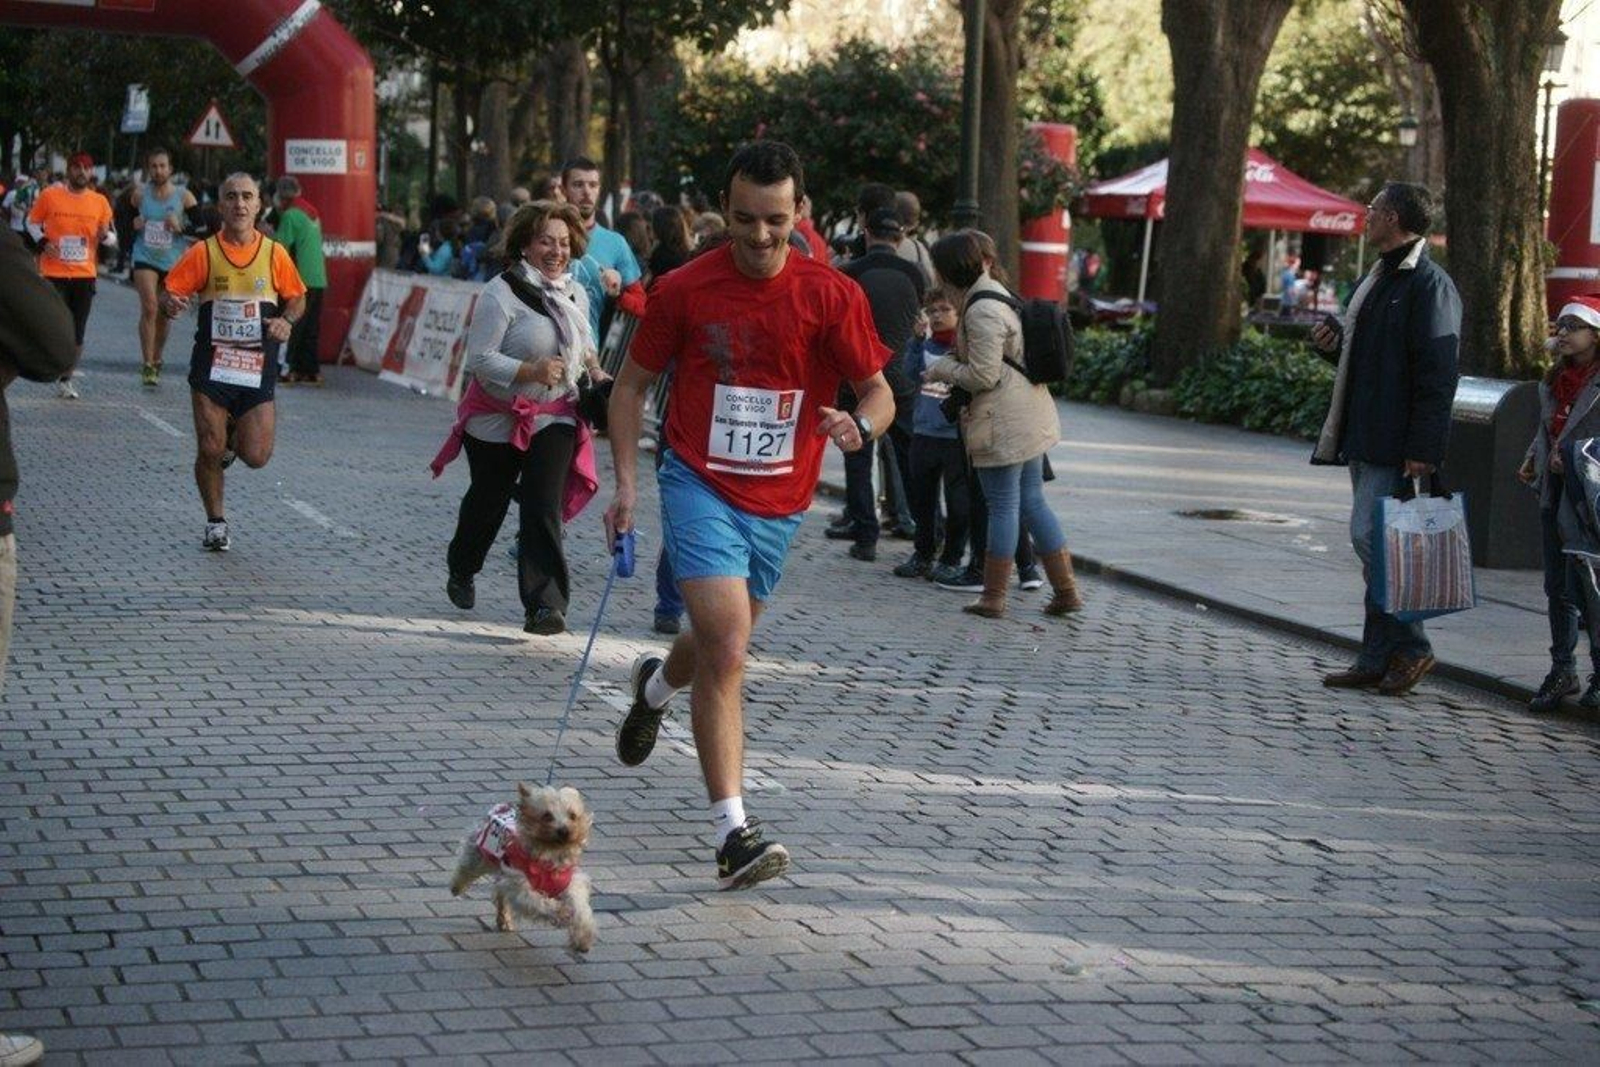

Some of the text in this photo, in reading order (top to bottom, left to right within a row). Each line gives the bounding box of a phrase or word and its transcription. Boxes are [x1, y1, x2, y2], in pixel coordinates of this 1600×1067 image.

[289, 146, 342, 156] CONCELLO
[294, 158, 336, 167] DE VIGO
[217, 324, 255, 338] 0142
[726, 394, 772, 405] CONCELLO
[730, 404, 767, 413] DE VIGO
[725, 430, 787, 457] 1127
